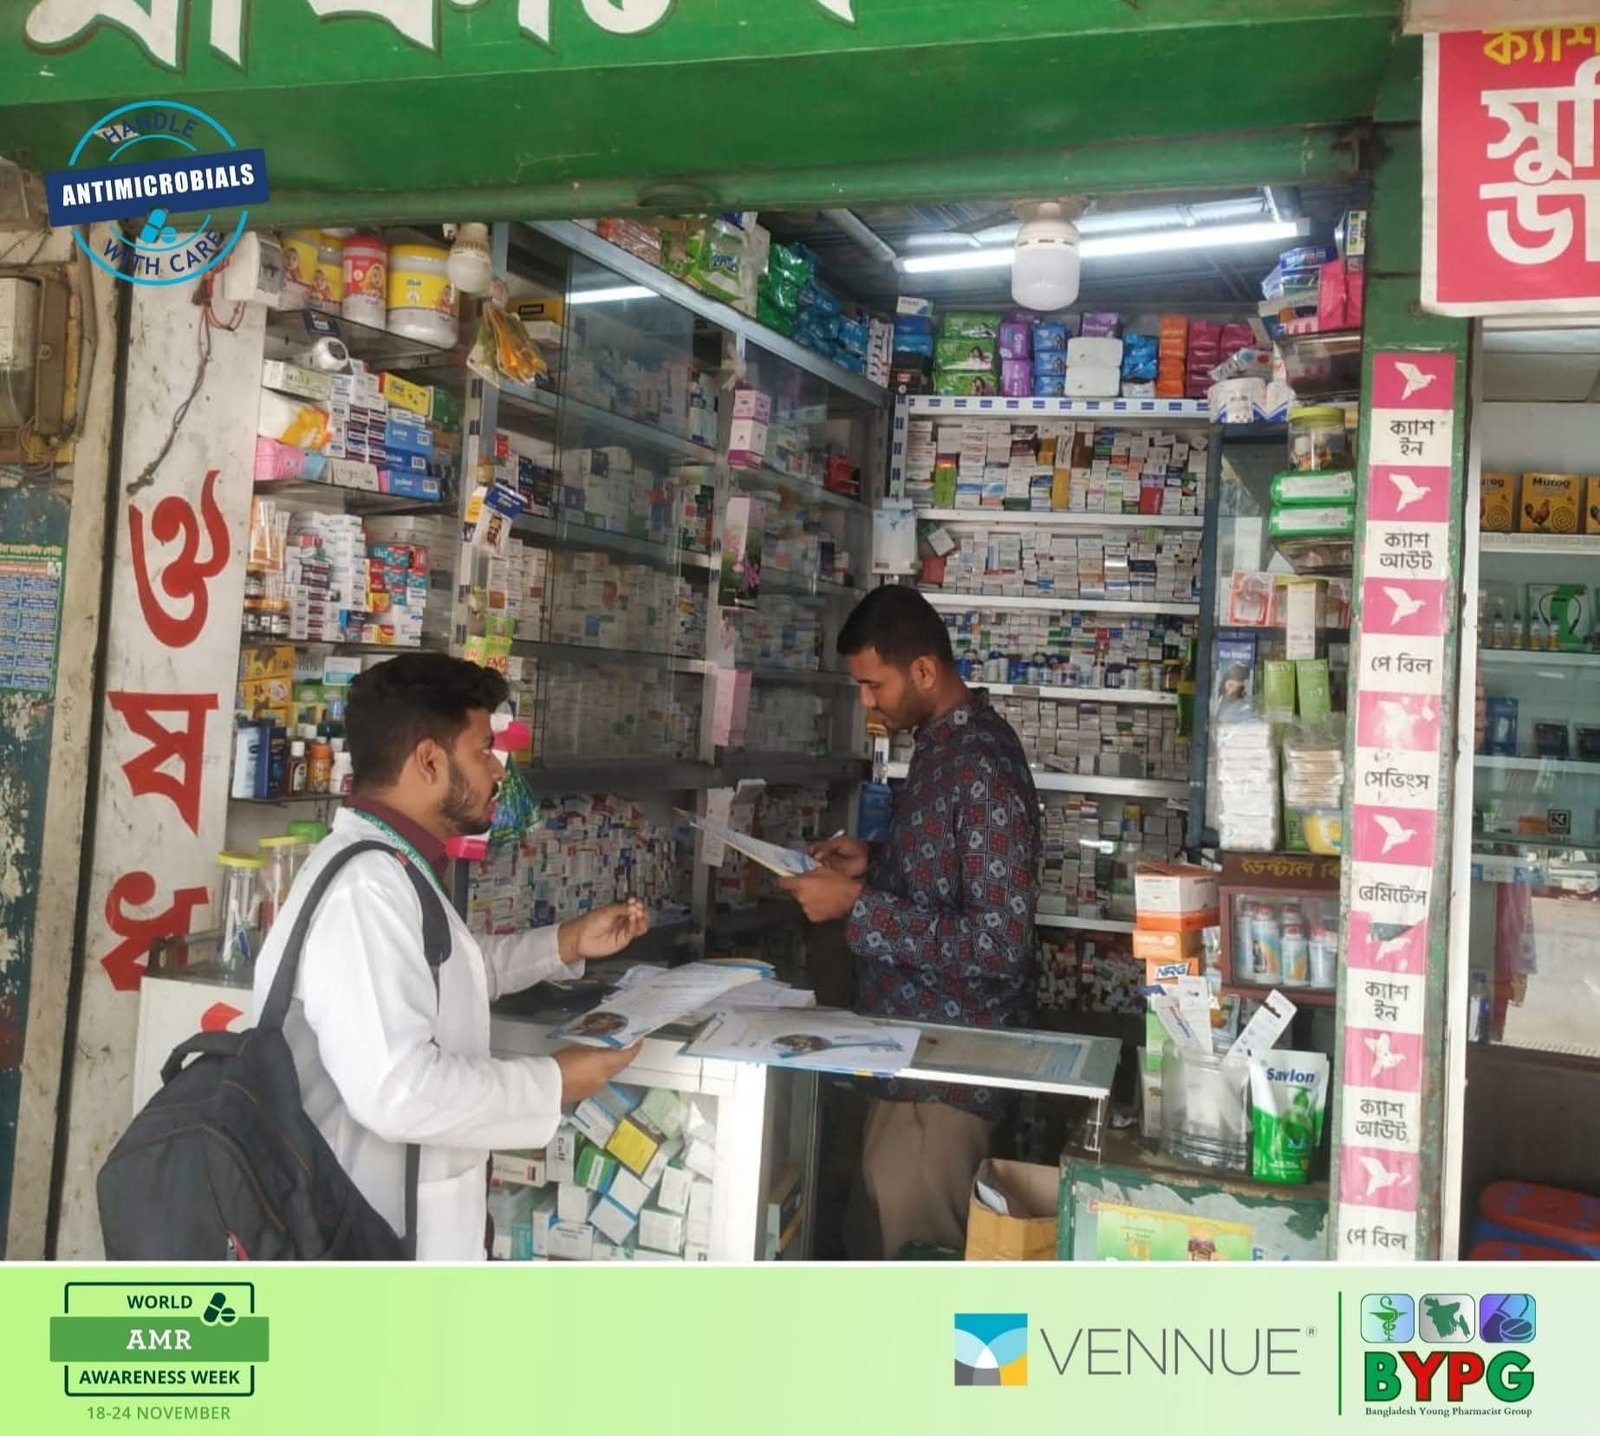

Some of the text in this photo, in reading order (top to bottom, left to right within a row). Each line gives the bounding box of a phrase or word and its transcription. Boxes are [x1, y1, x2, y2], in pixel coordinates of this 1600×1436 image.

[1390, 419, 1435, 436] ক্যাশ
[1399, 437, 1424, 456] ইন
[1384, 532, 1430, 549] ক্যাশ
[1380, 550, 1434, 569] আউট
[1371, 652, 1433, 675] পে বিল
[1365, 767, 1430, 790] সেভিংস
[1365, 980, 1409, 1000] ক্যাশ
[1374, 1000, 1398, 1022] ইন
[1267, 1067, 1316, 1083] Savlon
[1360, 1098, 1404, 1119] ক্যাশ
[1356, 1120, 1408, 1141] আউট
[1347, 1225, 1407, 1250] পে বিল
